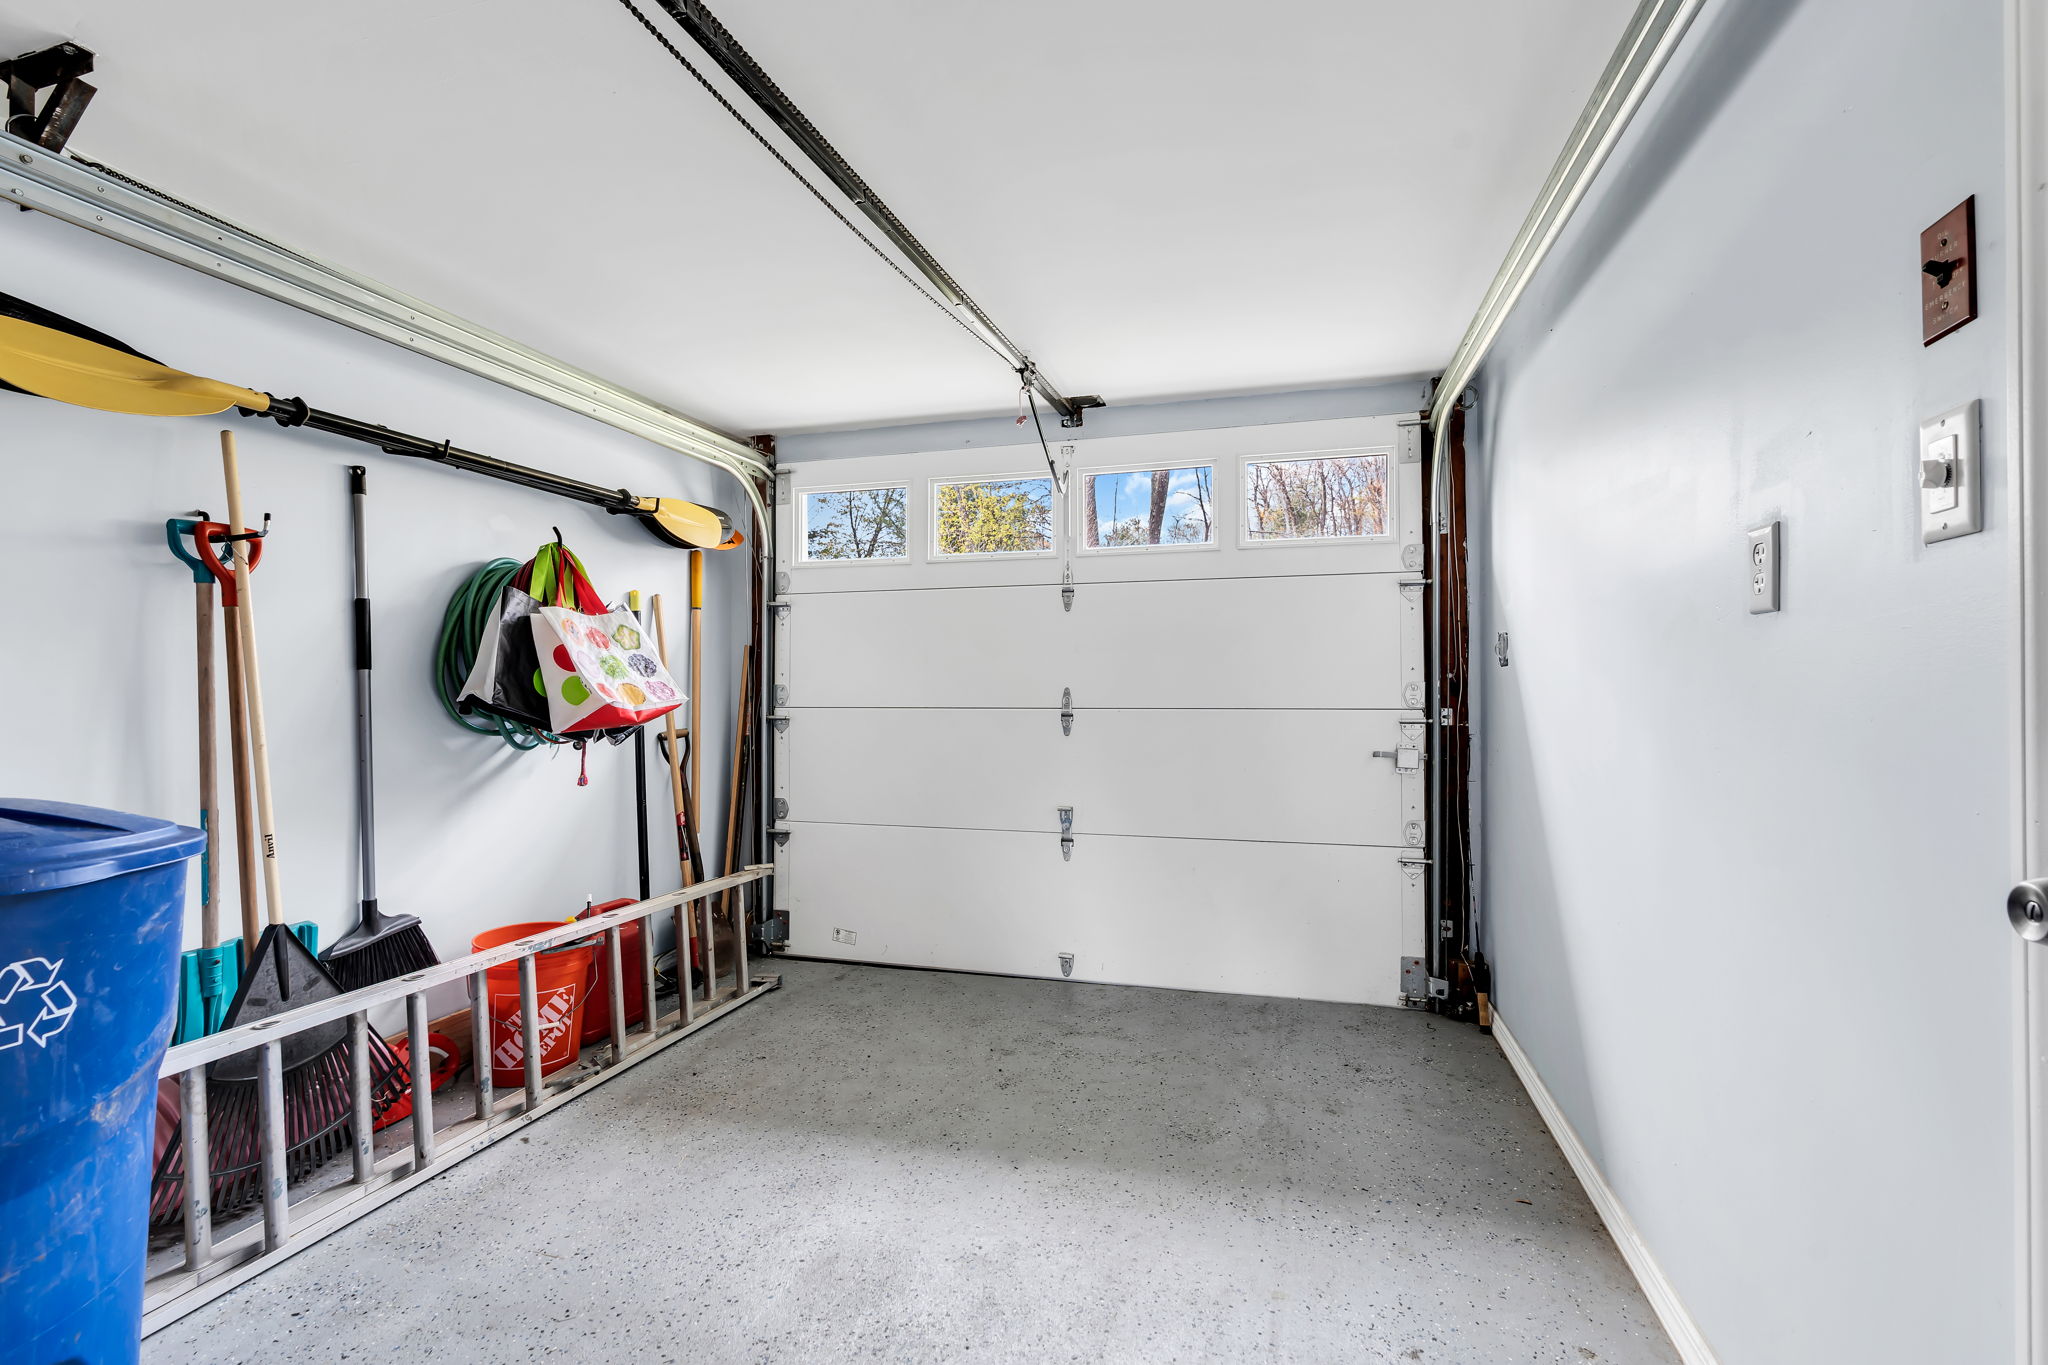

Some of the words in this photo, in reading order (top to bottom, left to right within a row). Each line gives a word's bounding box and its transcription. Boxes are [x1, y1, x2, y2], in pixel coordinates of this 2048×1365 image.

[1924, 280, 1965, 311] EMERGENCY
[264, 833, 275, 859] Anvil
[540, 1011, 571, 1057] EPOT
